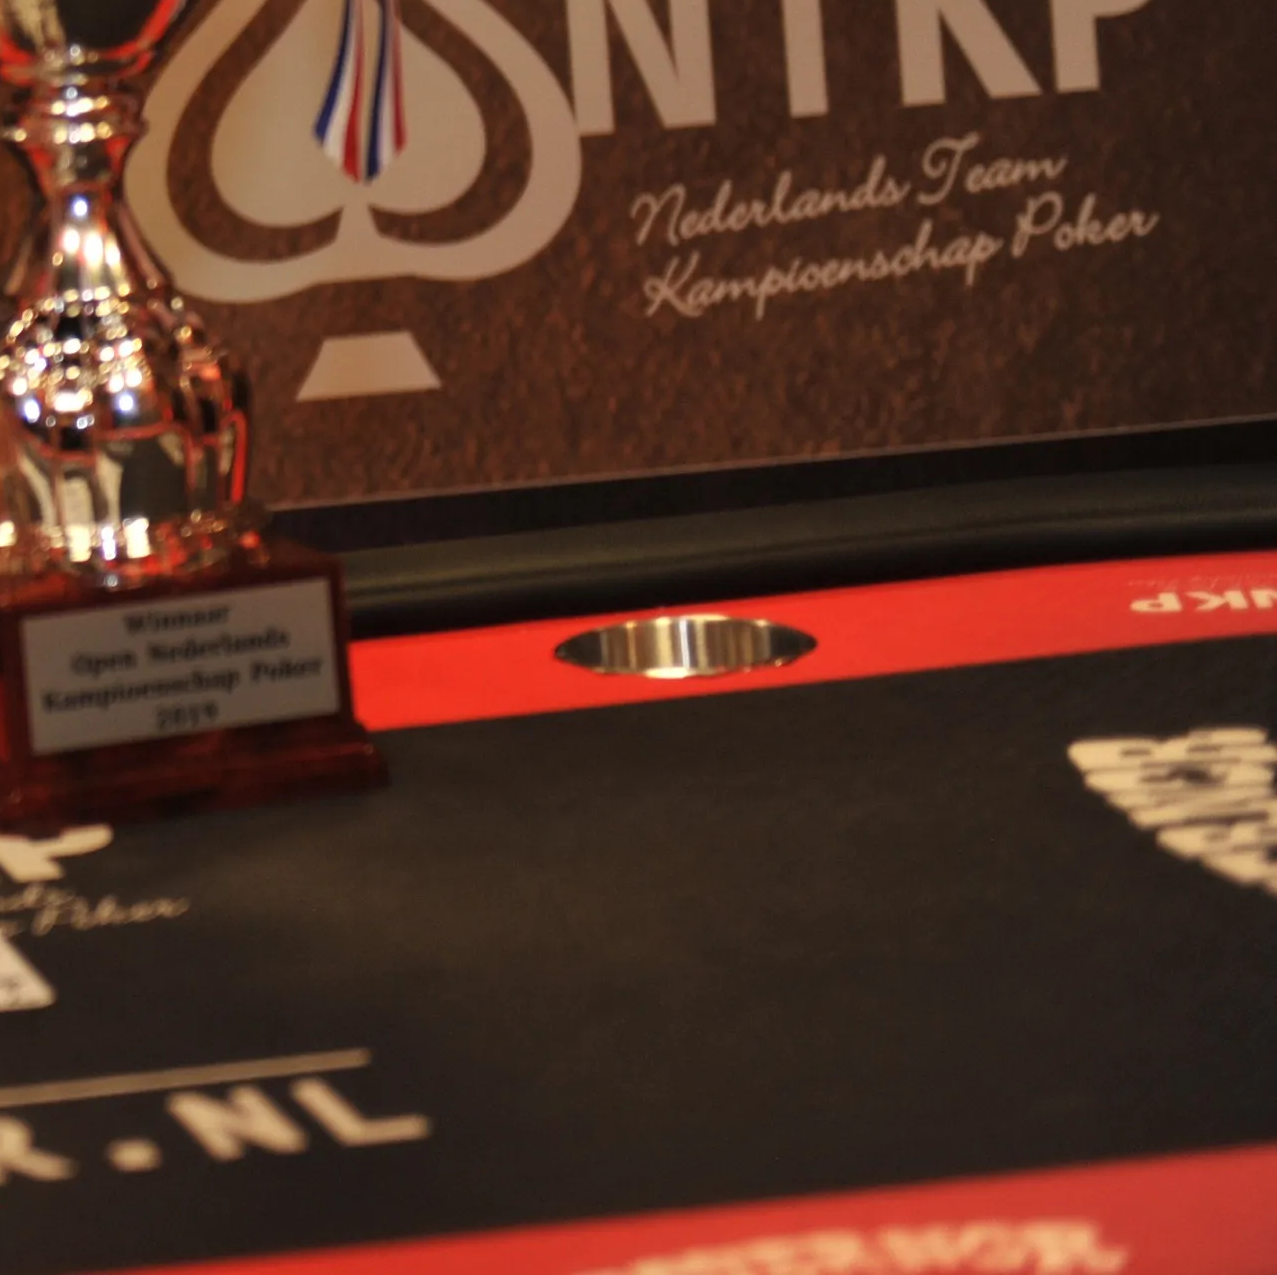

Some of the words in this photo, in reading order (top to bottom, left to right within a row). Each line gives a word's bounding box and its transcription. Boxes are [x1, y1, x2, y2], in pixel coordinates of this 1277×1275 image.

[629, 154, 910, 246] Nederlands
[916, 130, 1068, 206] Team
[644, 218, 1004, 321] Kampioenschap
[1010, 190, 1160, 259] Poker
[69, 649, 138, 681] Open
